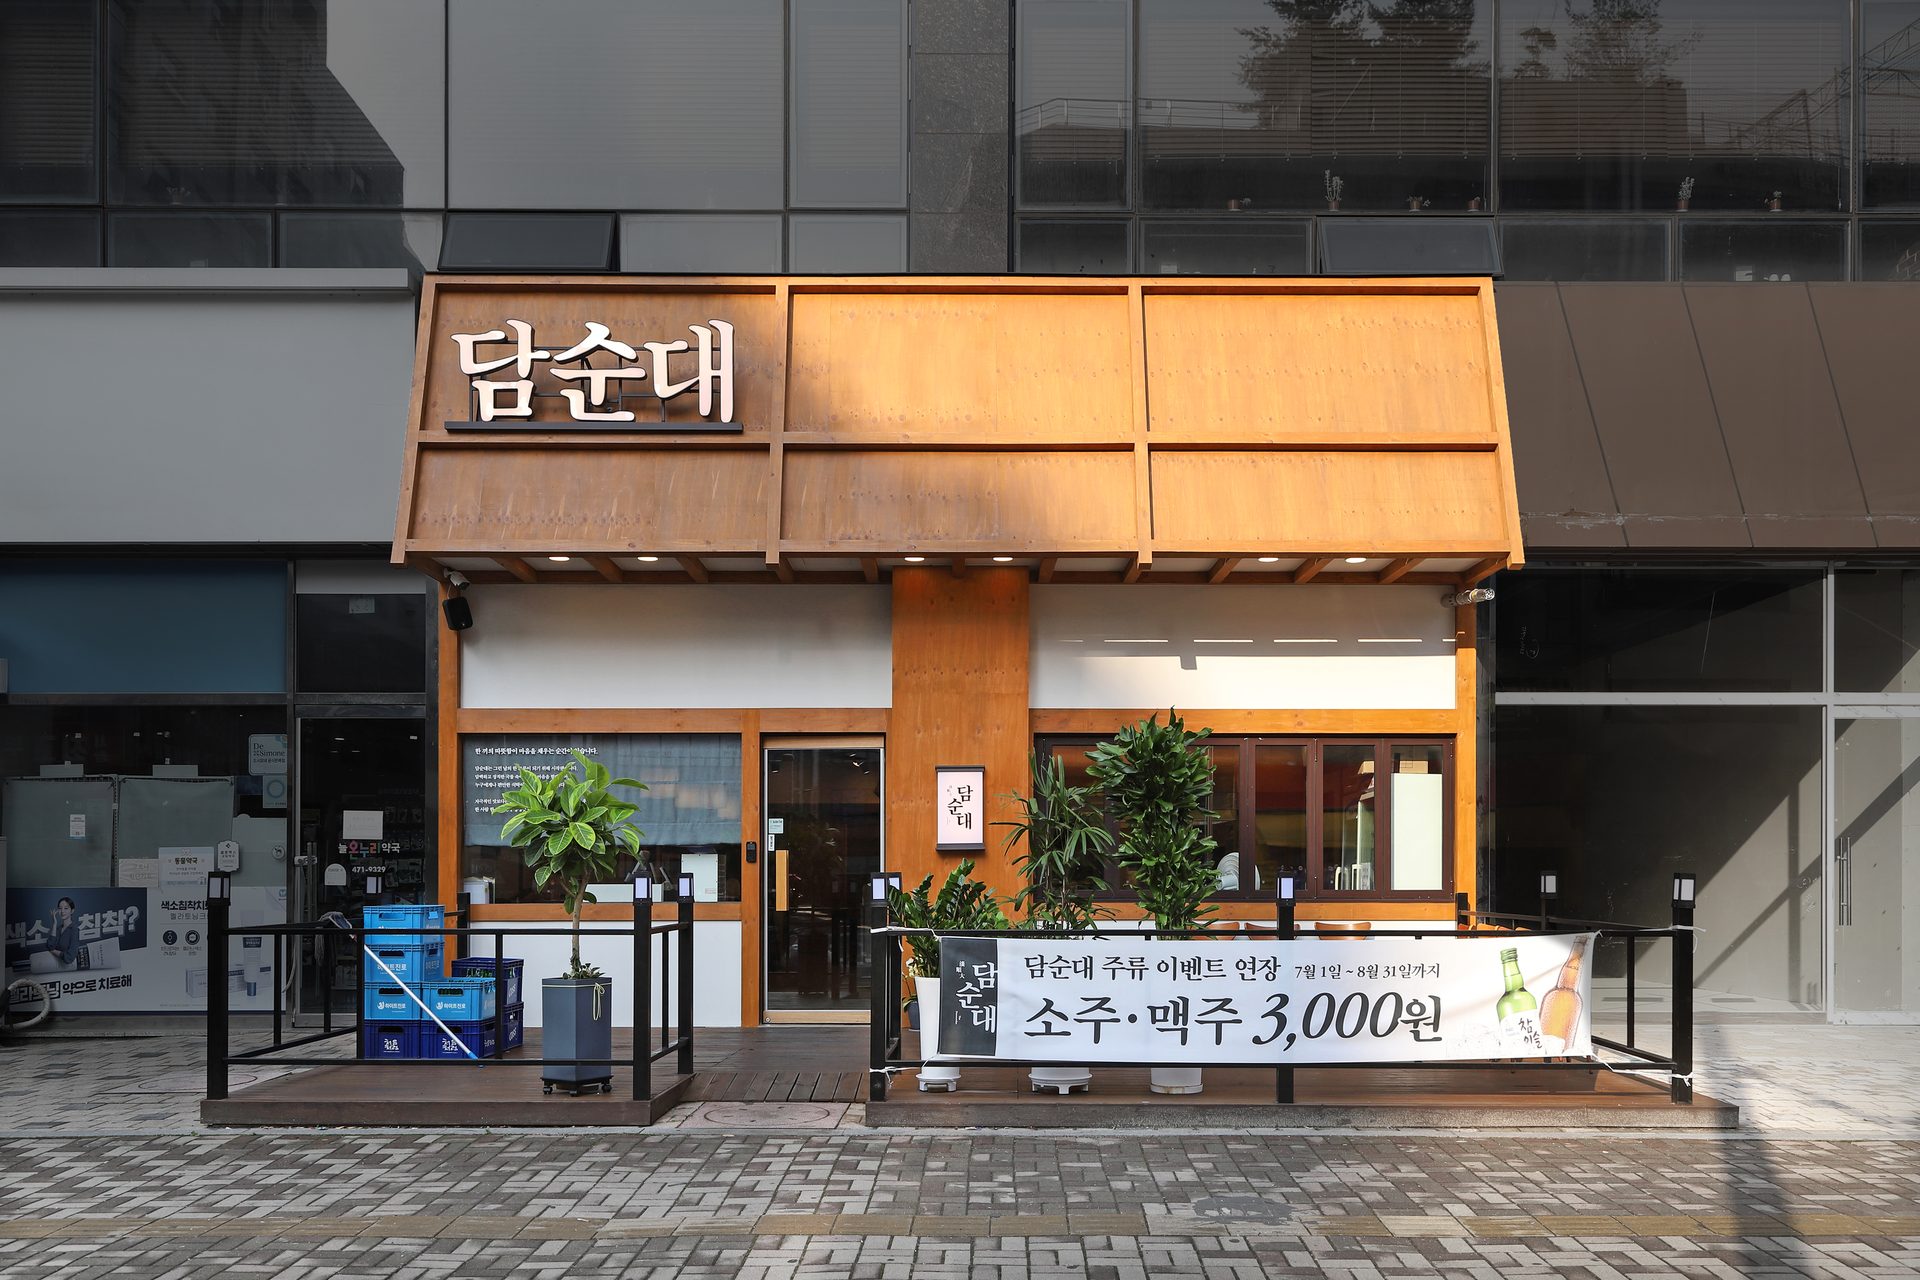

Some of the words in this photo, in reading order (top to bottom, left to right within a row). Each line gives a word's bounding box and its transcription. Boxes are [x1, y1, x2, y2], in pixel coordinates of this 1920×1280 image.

[450, 319, 735, 424] 담순대
[947, 785, 973, 830] 담순대
[78, 905, 140, 940] 침착?
[161, 900, 208, 911] 색소침착치
[62, 980, 98, 995] 약으로
[98, 974, 132, 990] 치료해
[1024, 954, 1094, 980] 담순대
[1102, 956, 1149, 981] 주류
[1156, 955, 1227, 982] 이벤트
[1235, 955, 1281, 982] 연장
[1294, 964, 1316, 980] 7월
[1321, 964, 1342, 980] 1일
[1357, 964, 1379, 980] 8월
[1382, 963, 1441, 980] 31일까지
[956, 962, 999, 1033] 담순대
[1252, 991, 1443, 1052] 3,000원
